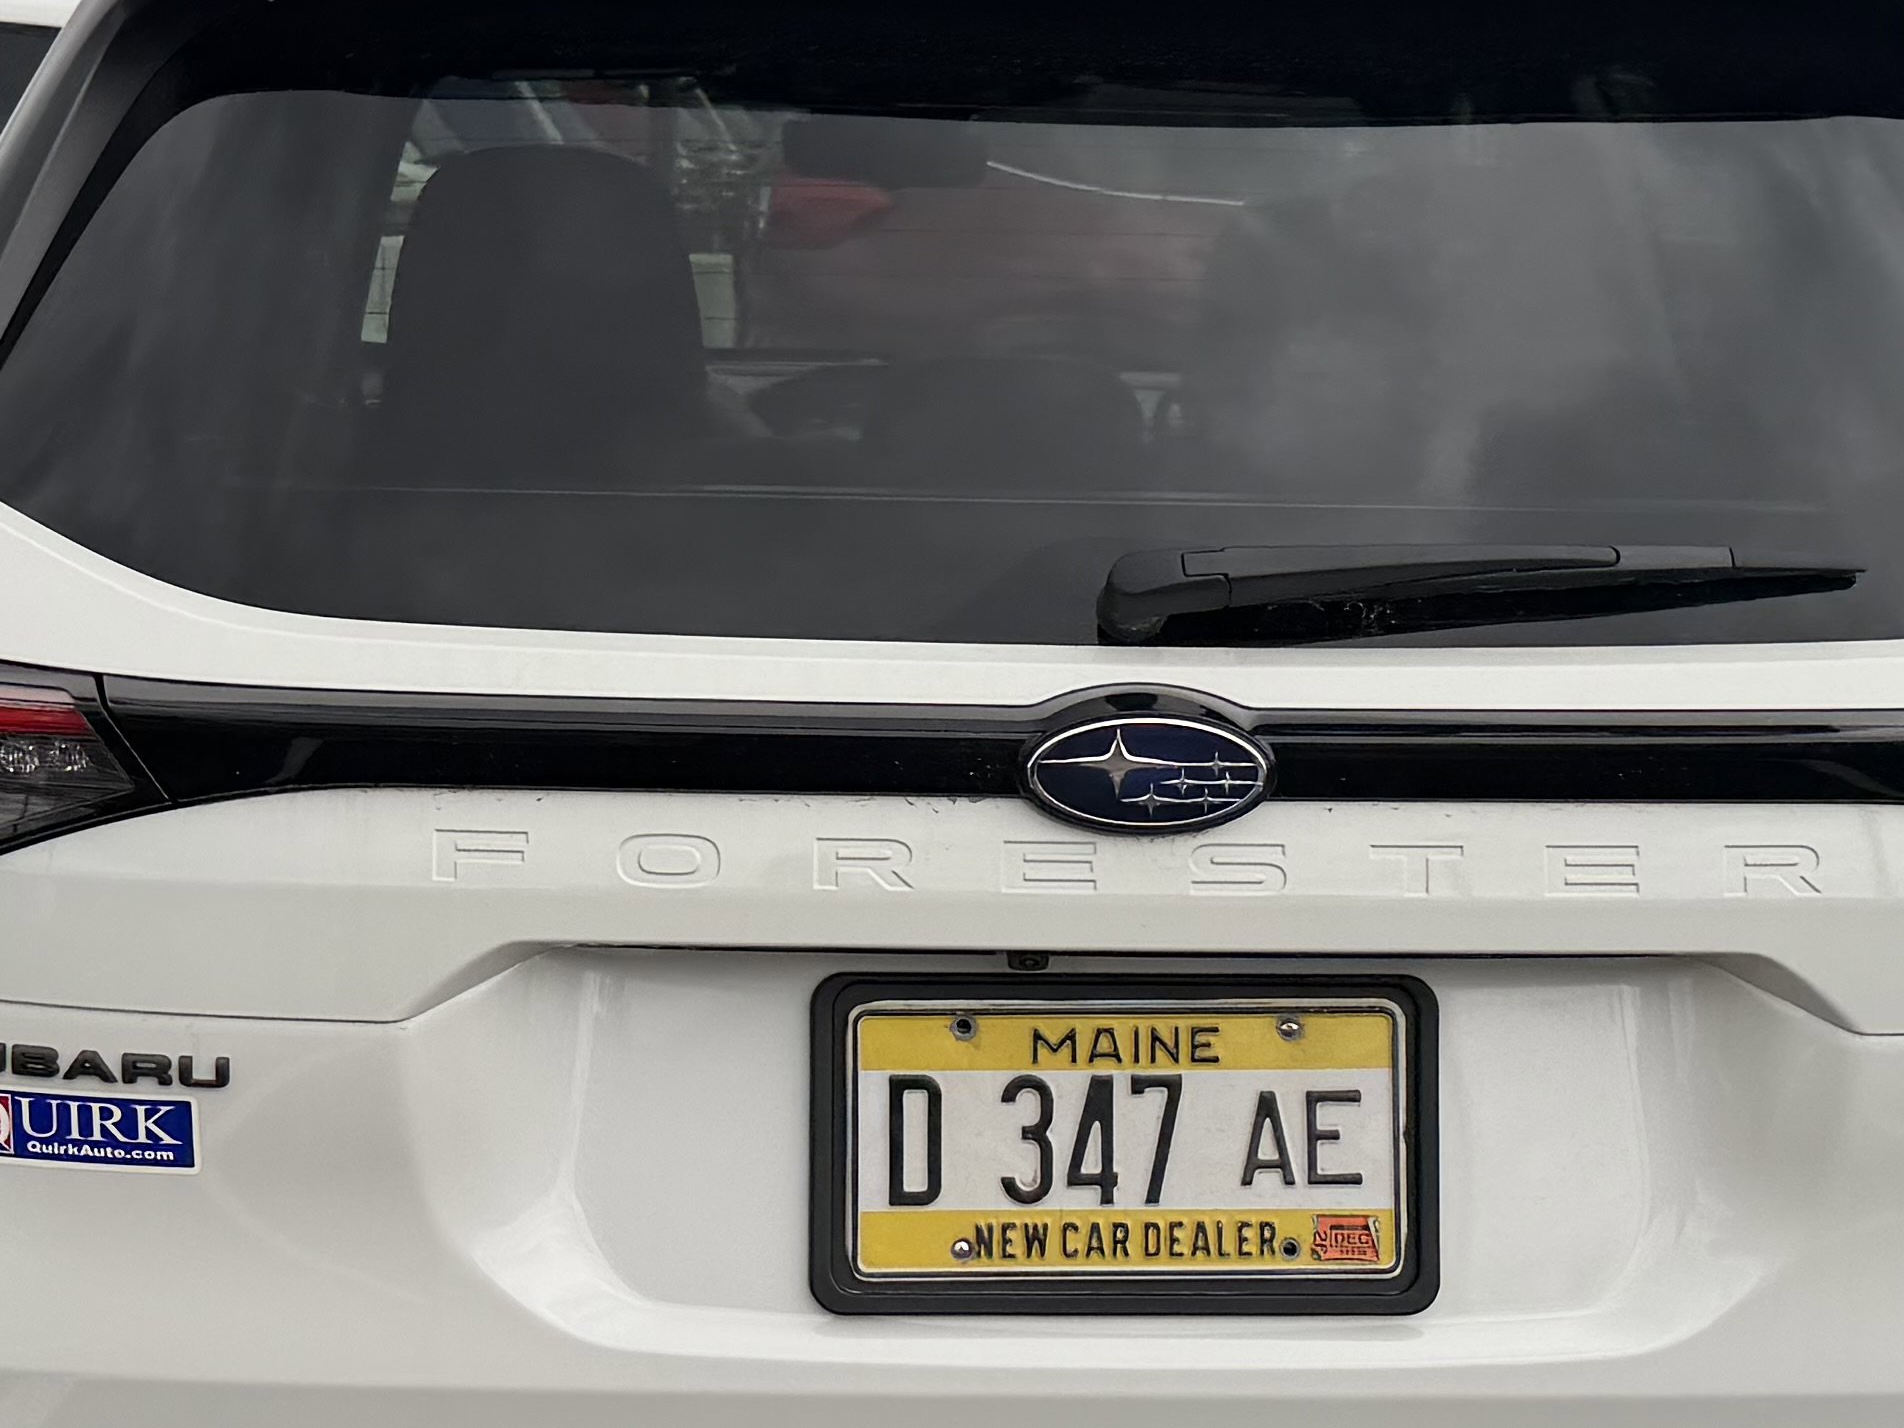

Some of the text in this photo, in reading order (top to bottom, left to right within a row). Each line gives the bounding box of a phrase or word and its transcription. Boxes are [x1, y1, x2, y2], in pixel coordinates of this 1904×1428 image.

[431, 828, 1824, 897] FORESTER
[1030, 1026, 1221, 1065] MAINE
[26, 1140, 175, 1162] QuirkAuto.com
[888, 1074, 1364, 1206] D 347 AE
[974, 1222, 1276, 1259] NEW CAR DEALER
